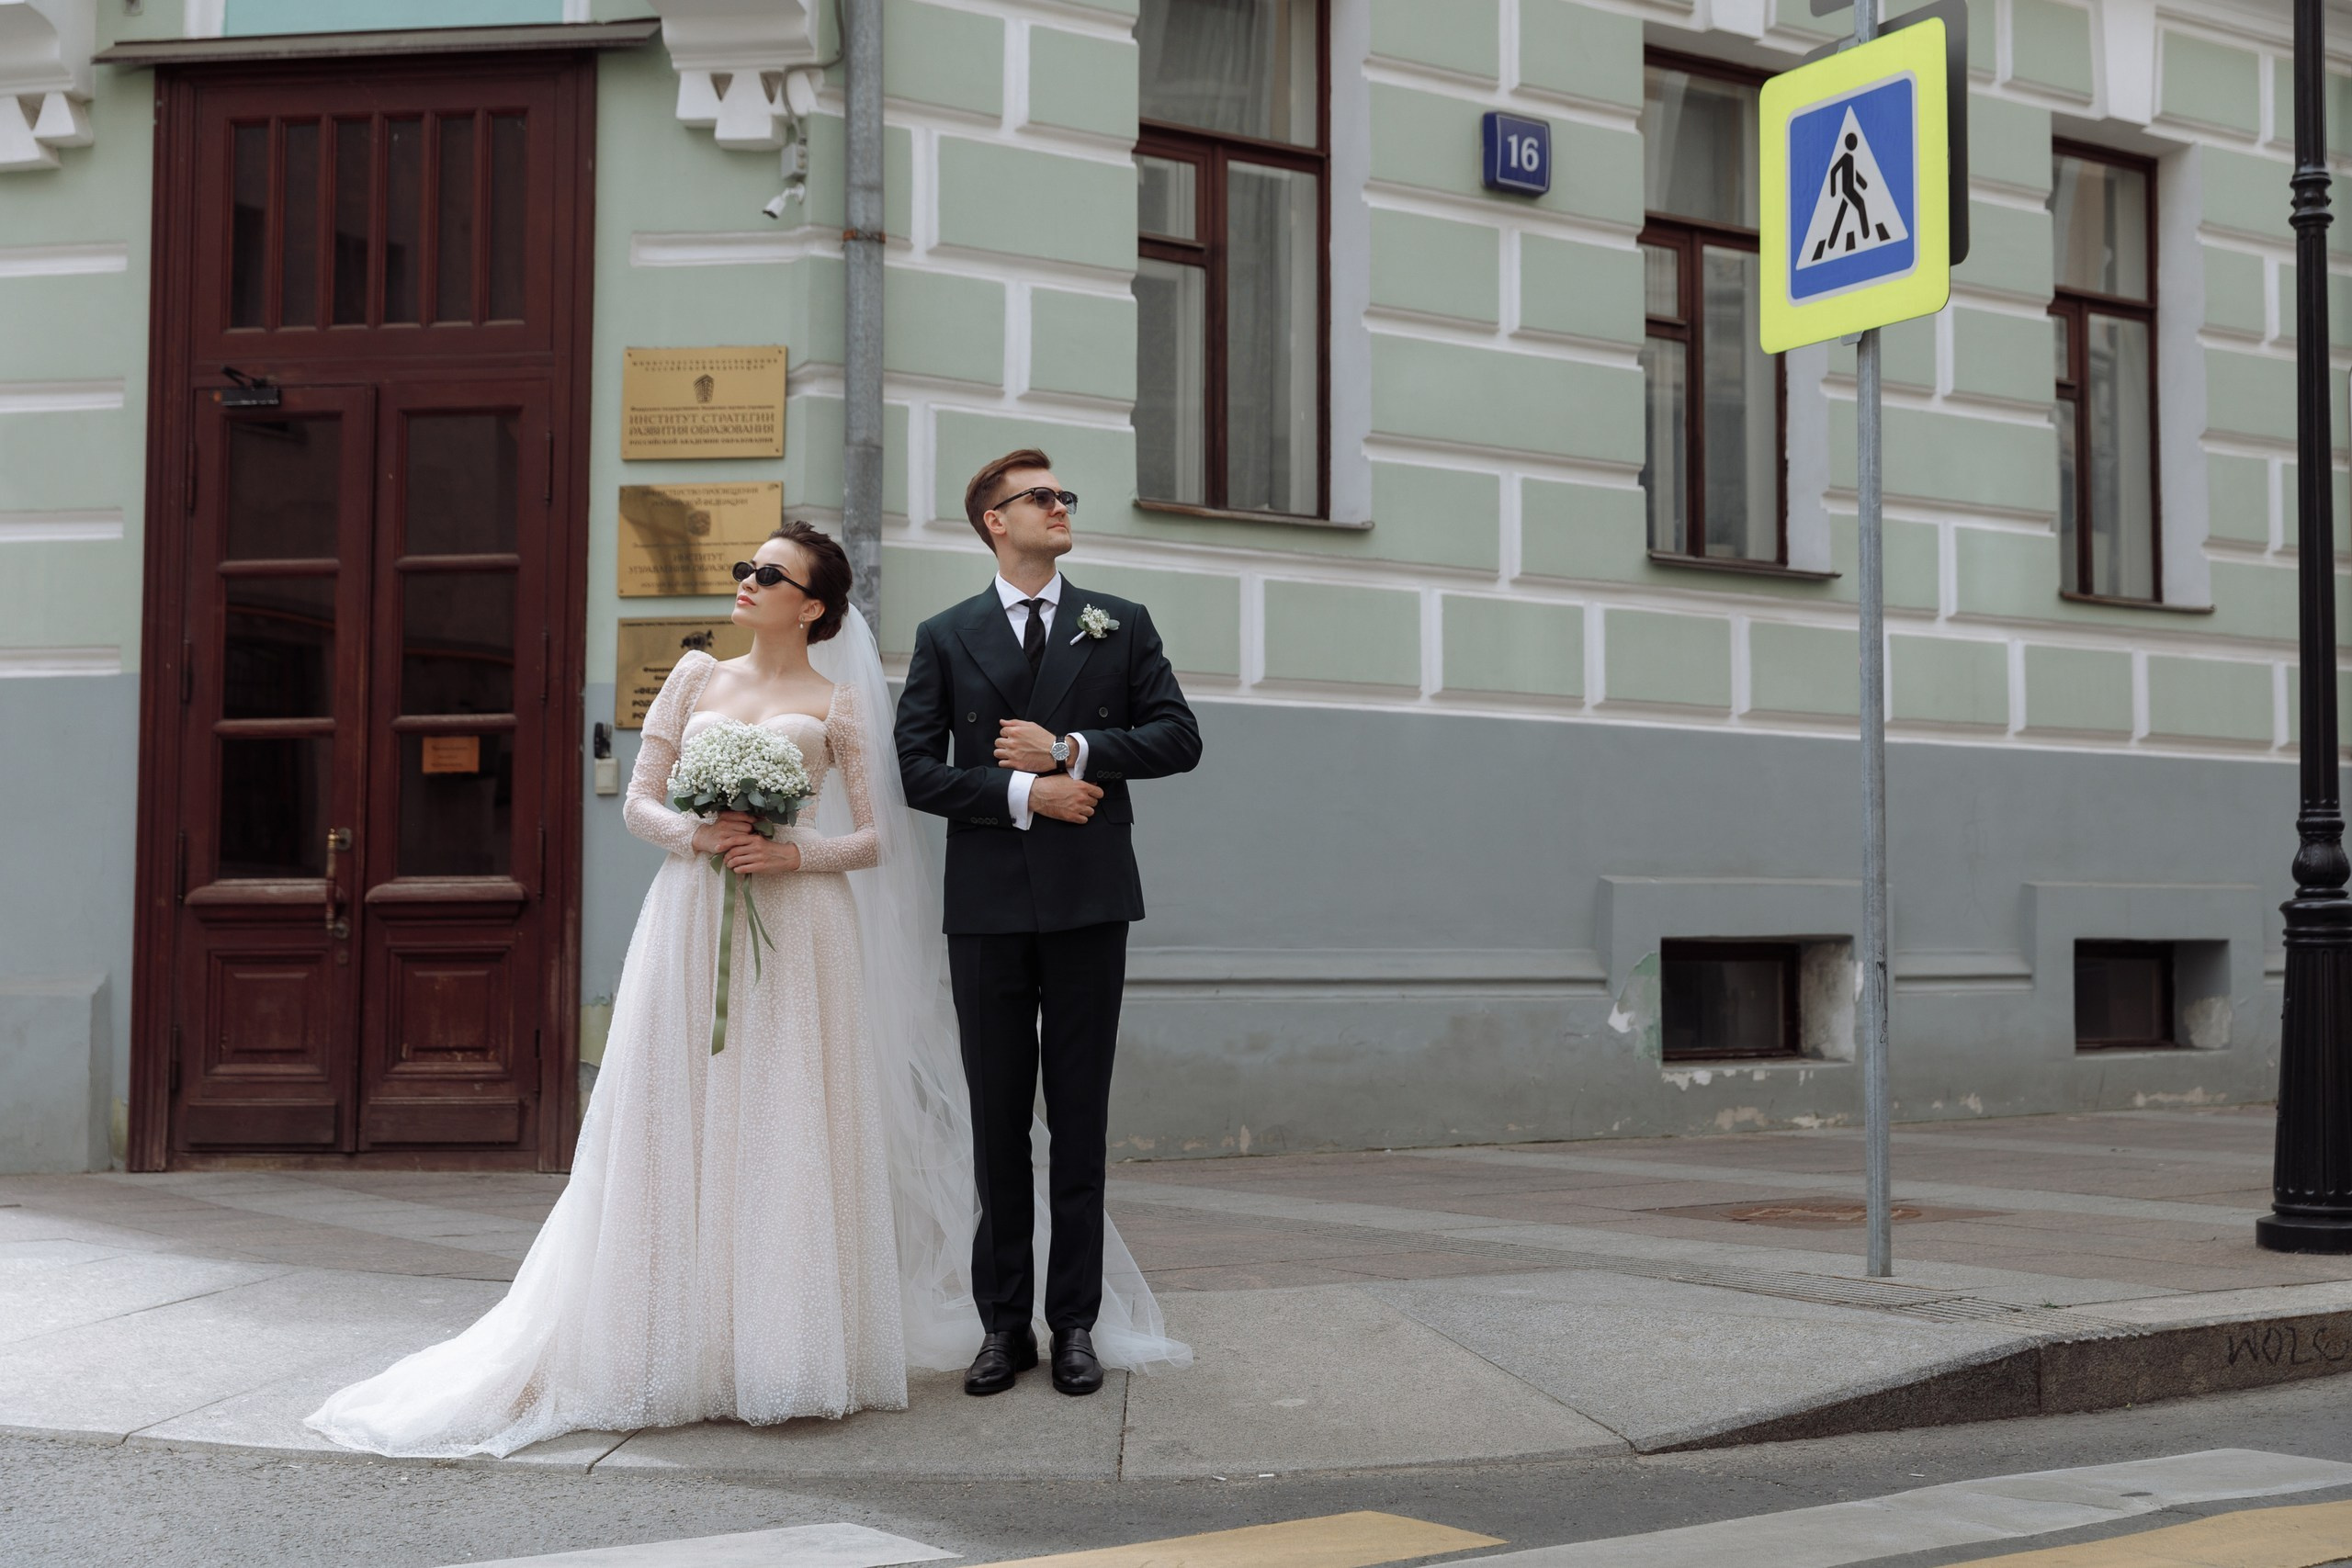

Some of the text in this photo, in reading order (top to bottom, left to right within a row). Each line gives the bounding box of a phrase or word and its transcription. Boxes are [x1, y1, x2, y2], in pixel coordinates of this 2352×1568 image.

[1507, 133, 1540, 173] 16
[629, 412, 775, 425] ИНСТИТУТ СТРАТЕГИИ
[628, 423, 775, 436] РАЗВИТИЯ ОБРАЗОВАНИЯ
[673, 552, 724, 562] ИНСТИТУТ
